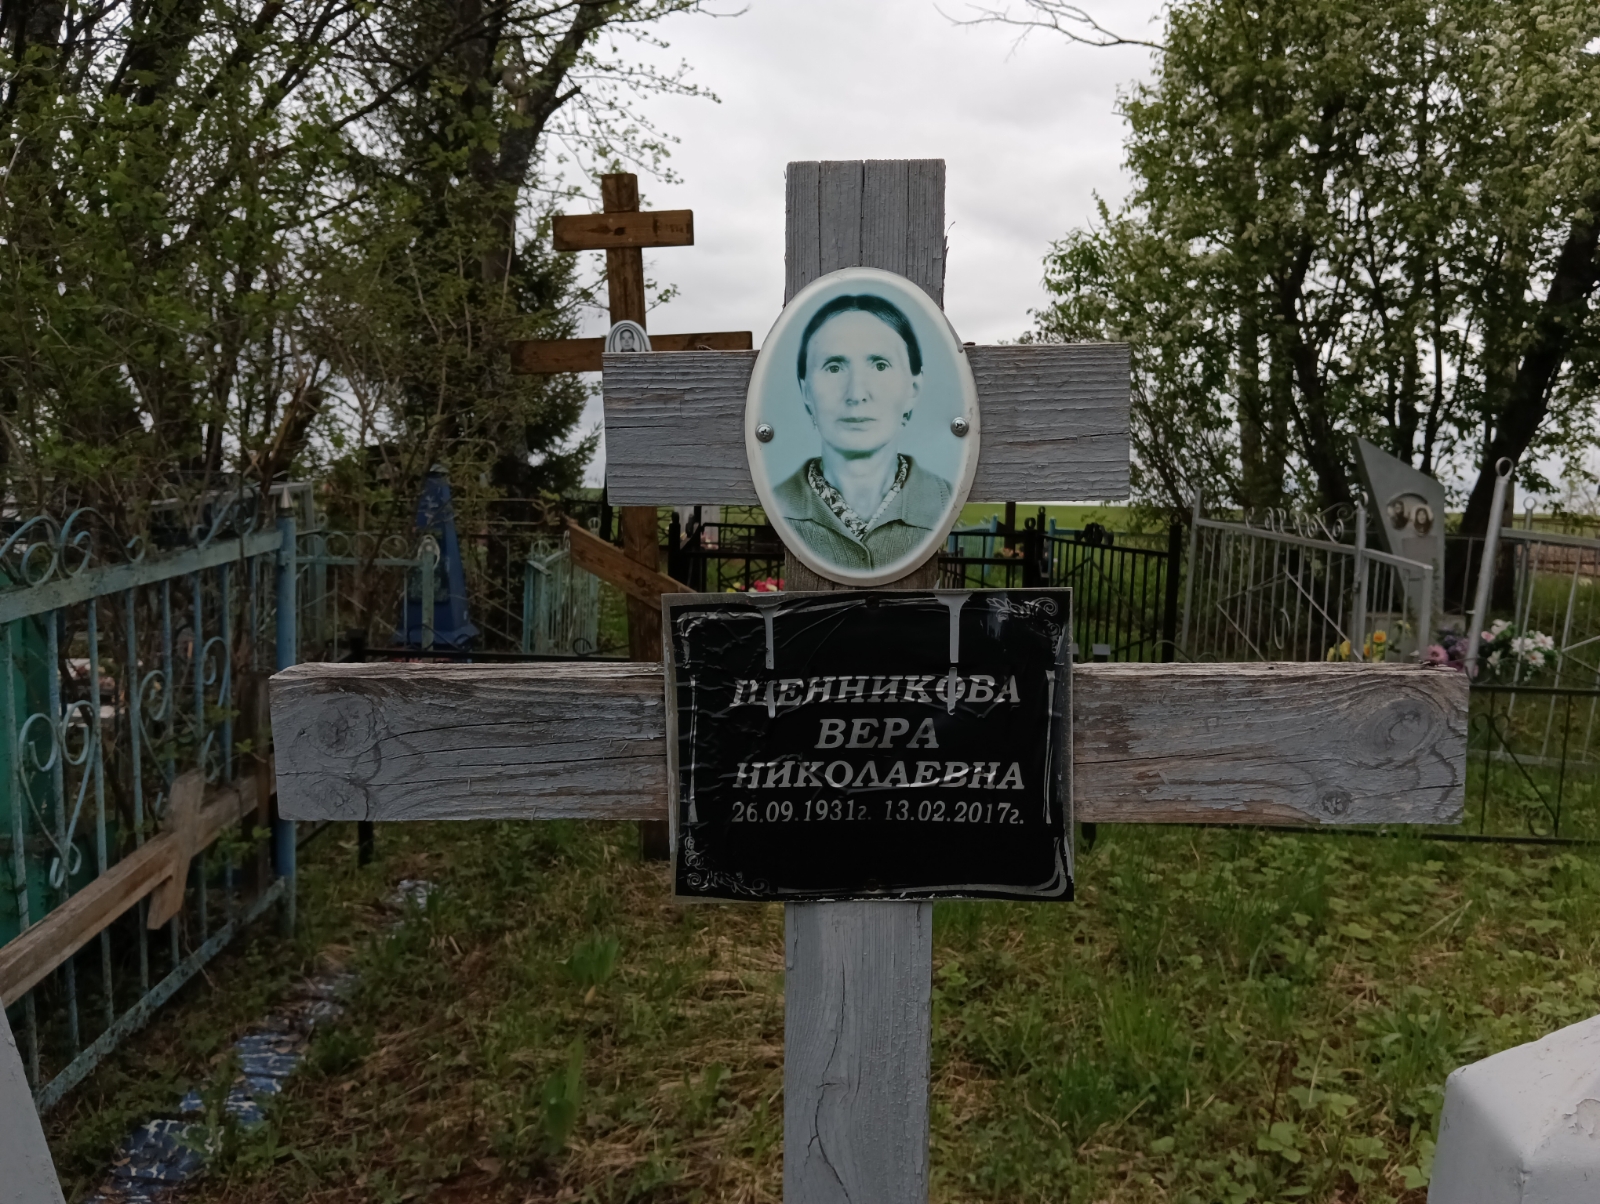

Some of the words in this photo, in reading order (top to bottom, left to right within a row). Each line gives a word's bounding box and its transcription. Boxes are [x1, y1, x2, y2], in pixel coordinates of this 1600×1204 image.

[814, 717, 940, 749] ВЕРА
[732, 760, 1025, 790] НИКОЛАЕВНА
[731, 800, 872, 823] 26.09.1931г.
[885, 799, 1024, 825] 13.02.2017г.
